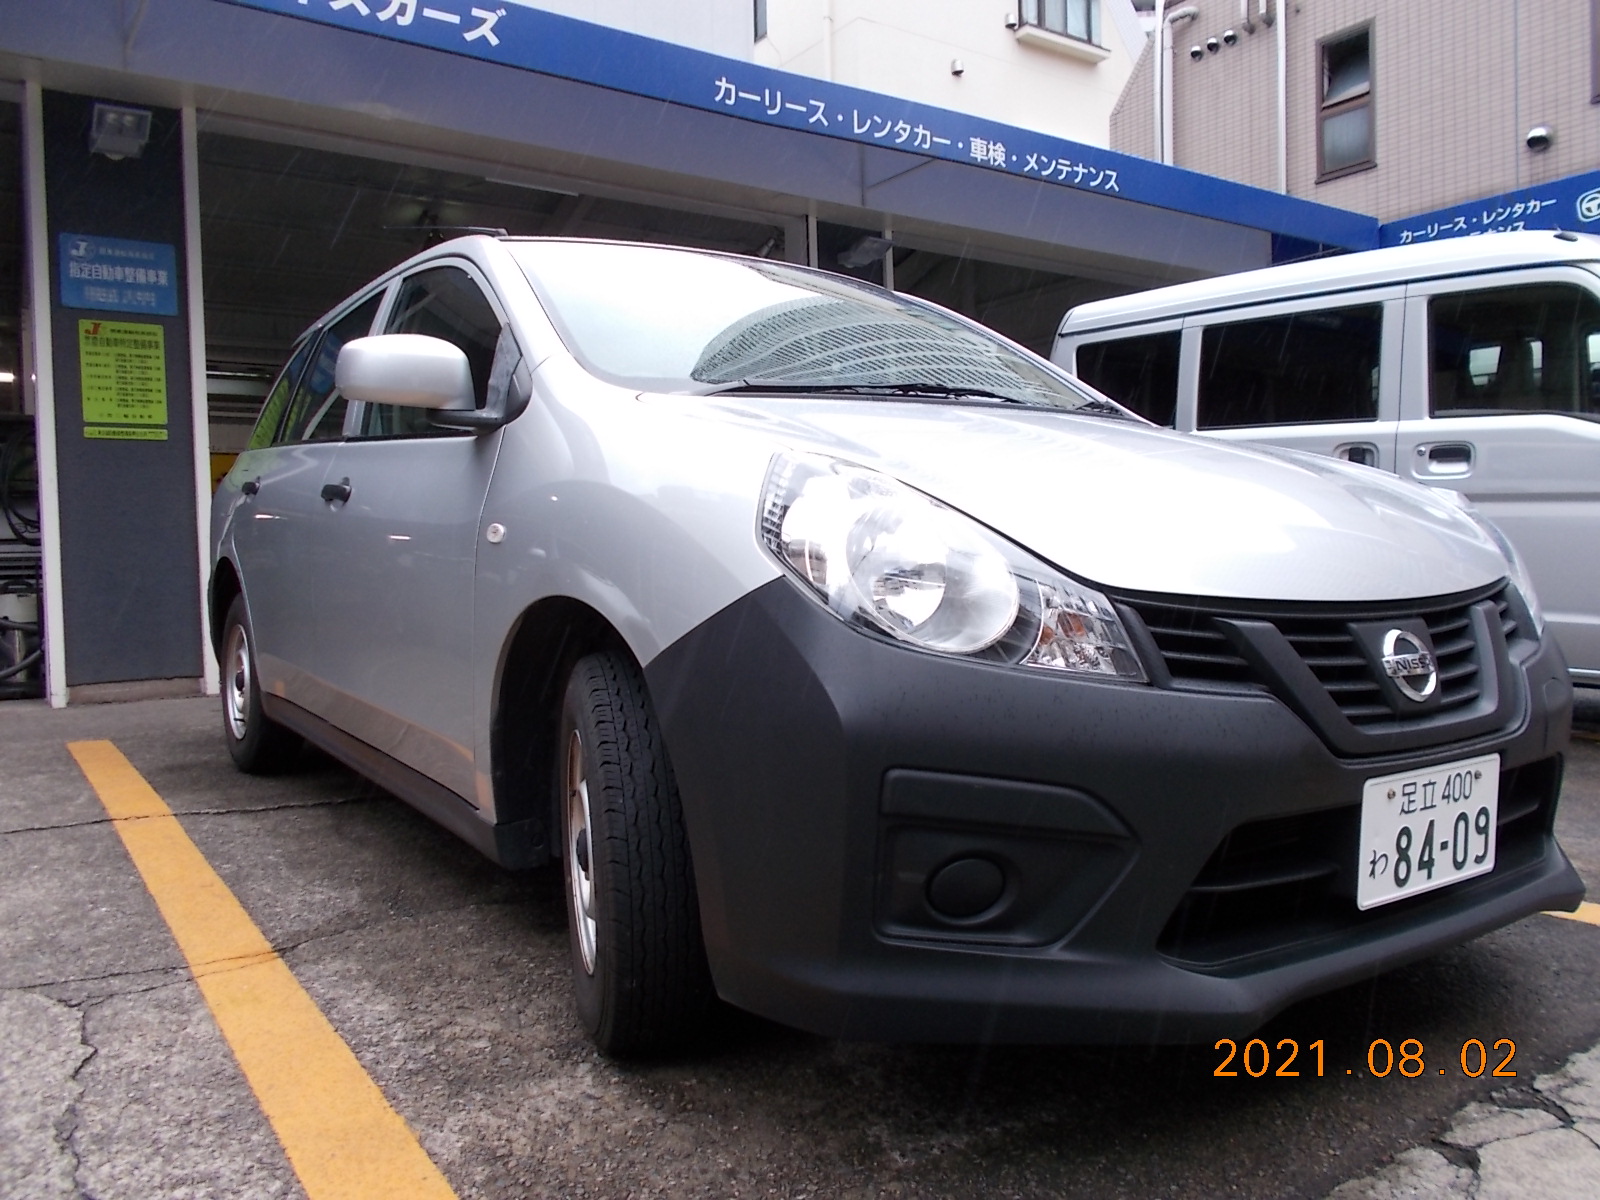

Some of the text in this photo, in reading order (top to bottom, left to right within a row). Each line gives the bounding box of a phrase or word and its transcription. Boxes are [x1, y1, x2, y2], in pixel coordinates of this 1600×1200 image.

[714, 76, 1121, 192] カーリース・レンタカー・車検・メンテナンス
[1400, 199, 1557, 244] カーリース・レンタカー
[69, 261, 169, 286] 指定自動車整備事業
[1400, 769, 1473, 815] 足立 400
[1369, 806, 1490, 888] わ 84-09
